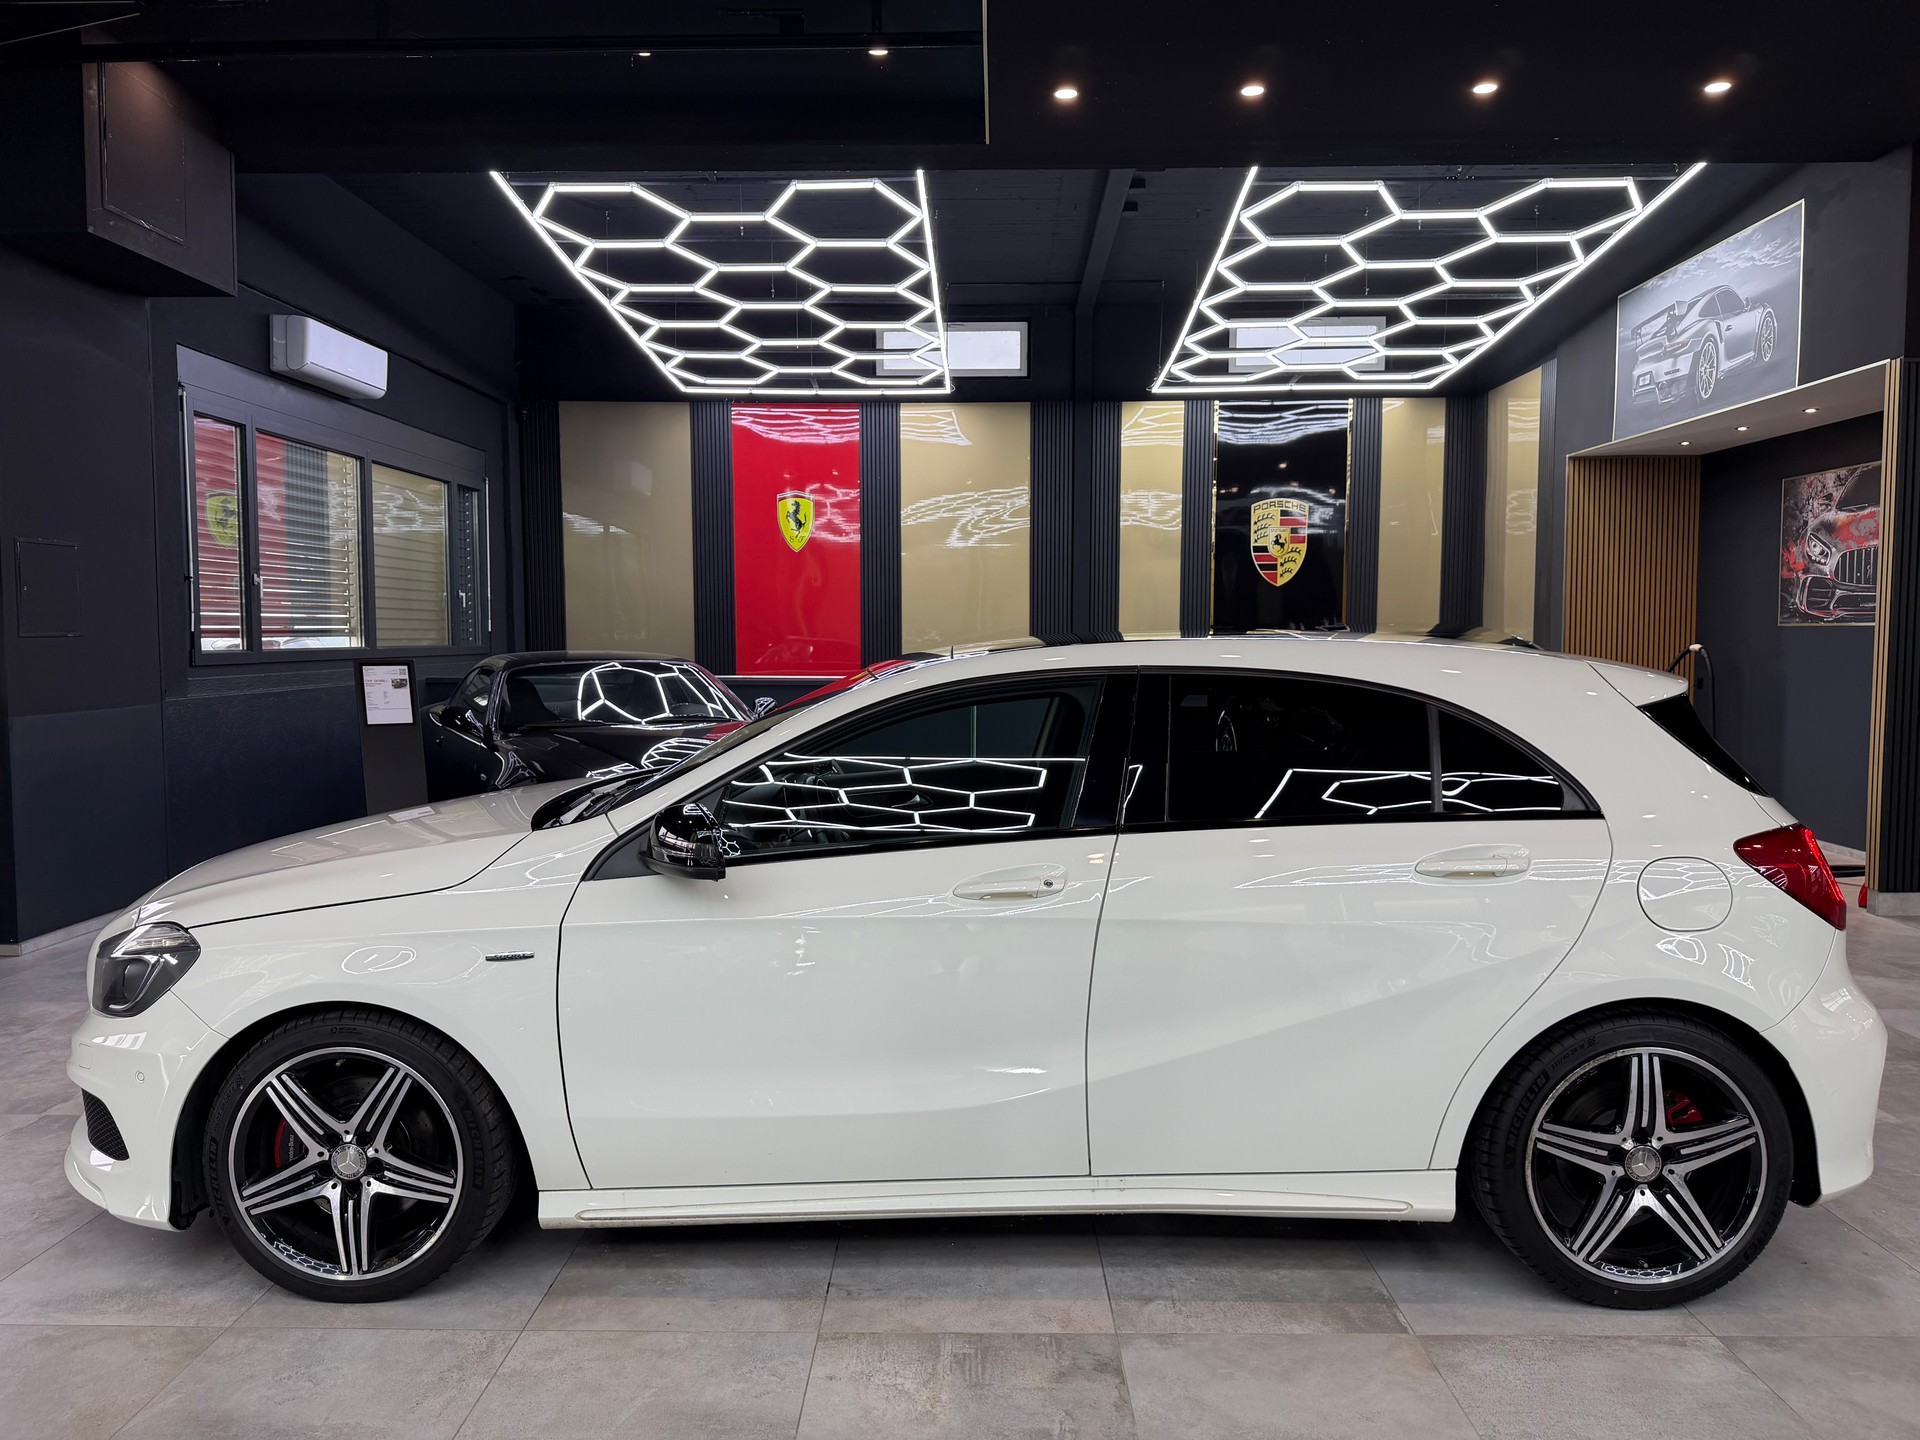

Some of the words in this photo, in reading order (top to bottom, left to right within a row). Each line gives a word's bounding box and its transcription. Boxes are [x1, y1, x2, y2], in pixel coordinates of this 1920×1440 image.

[1253, 500, 1307, 513] PORSCHE
[464, 1109, 483, 1186] MICHELIN
[1508, 1074, 1547, 1148] MICHELIN
[209, 1140, 229, 1218] MICHELIN
